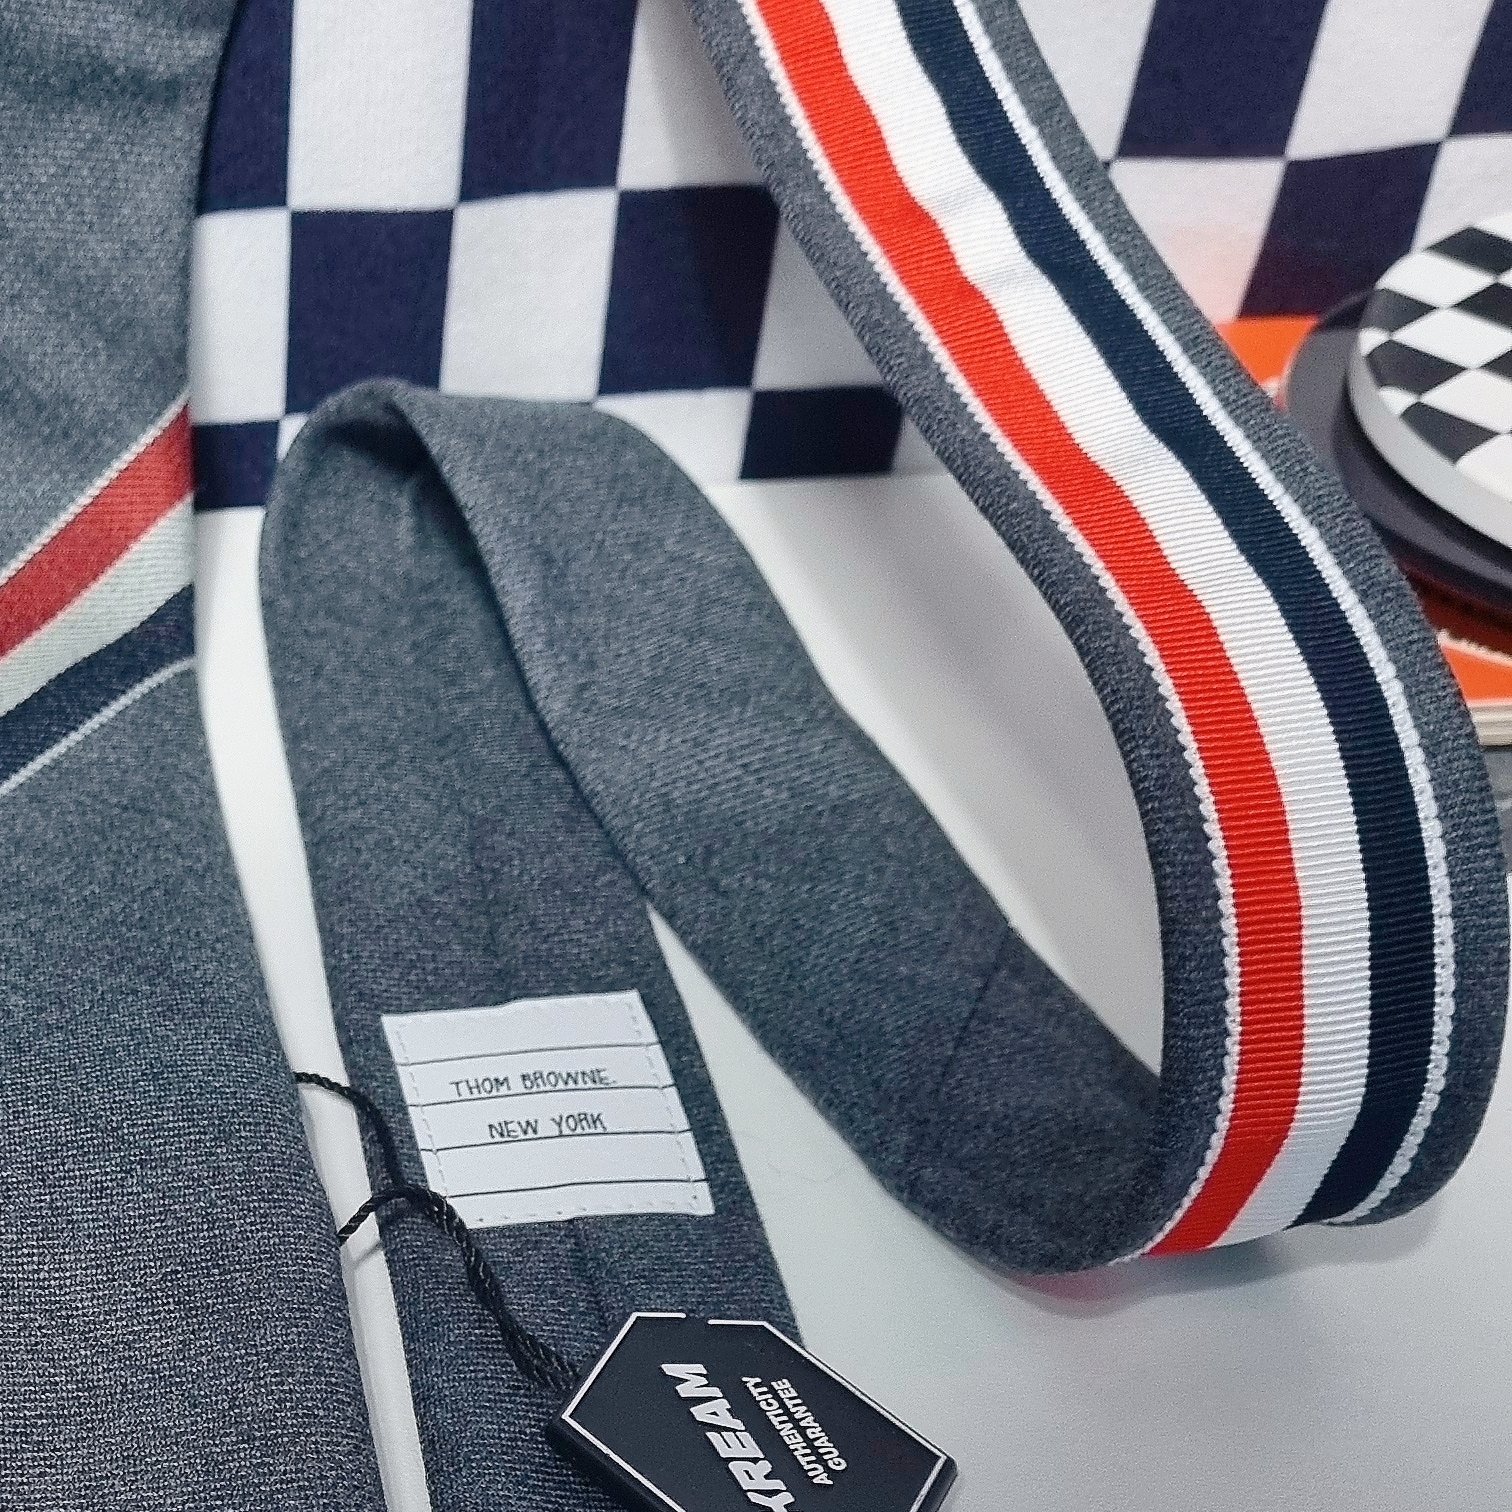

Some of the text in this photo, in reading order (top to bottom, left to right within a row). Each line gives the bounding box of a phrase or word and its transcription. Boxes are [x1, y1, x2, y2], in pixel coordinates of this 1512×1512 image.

[450, 1074, 512, 1099] THOM
[488, 1111, 608, 1141] NEW YORK
[741, 1376, 834, 1485] AUTHENTICITY
[770, 1378, 848, 1472] GUARANTEE
